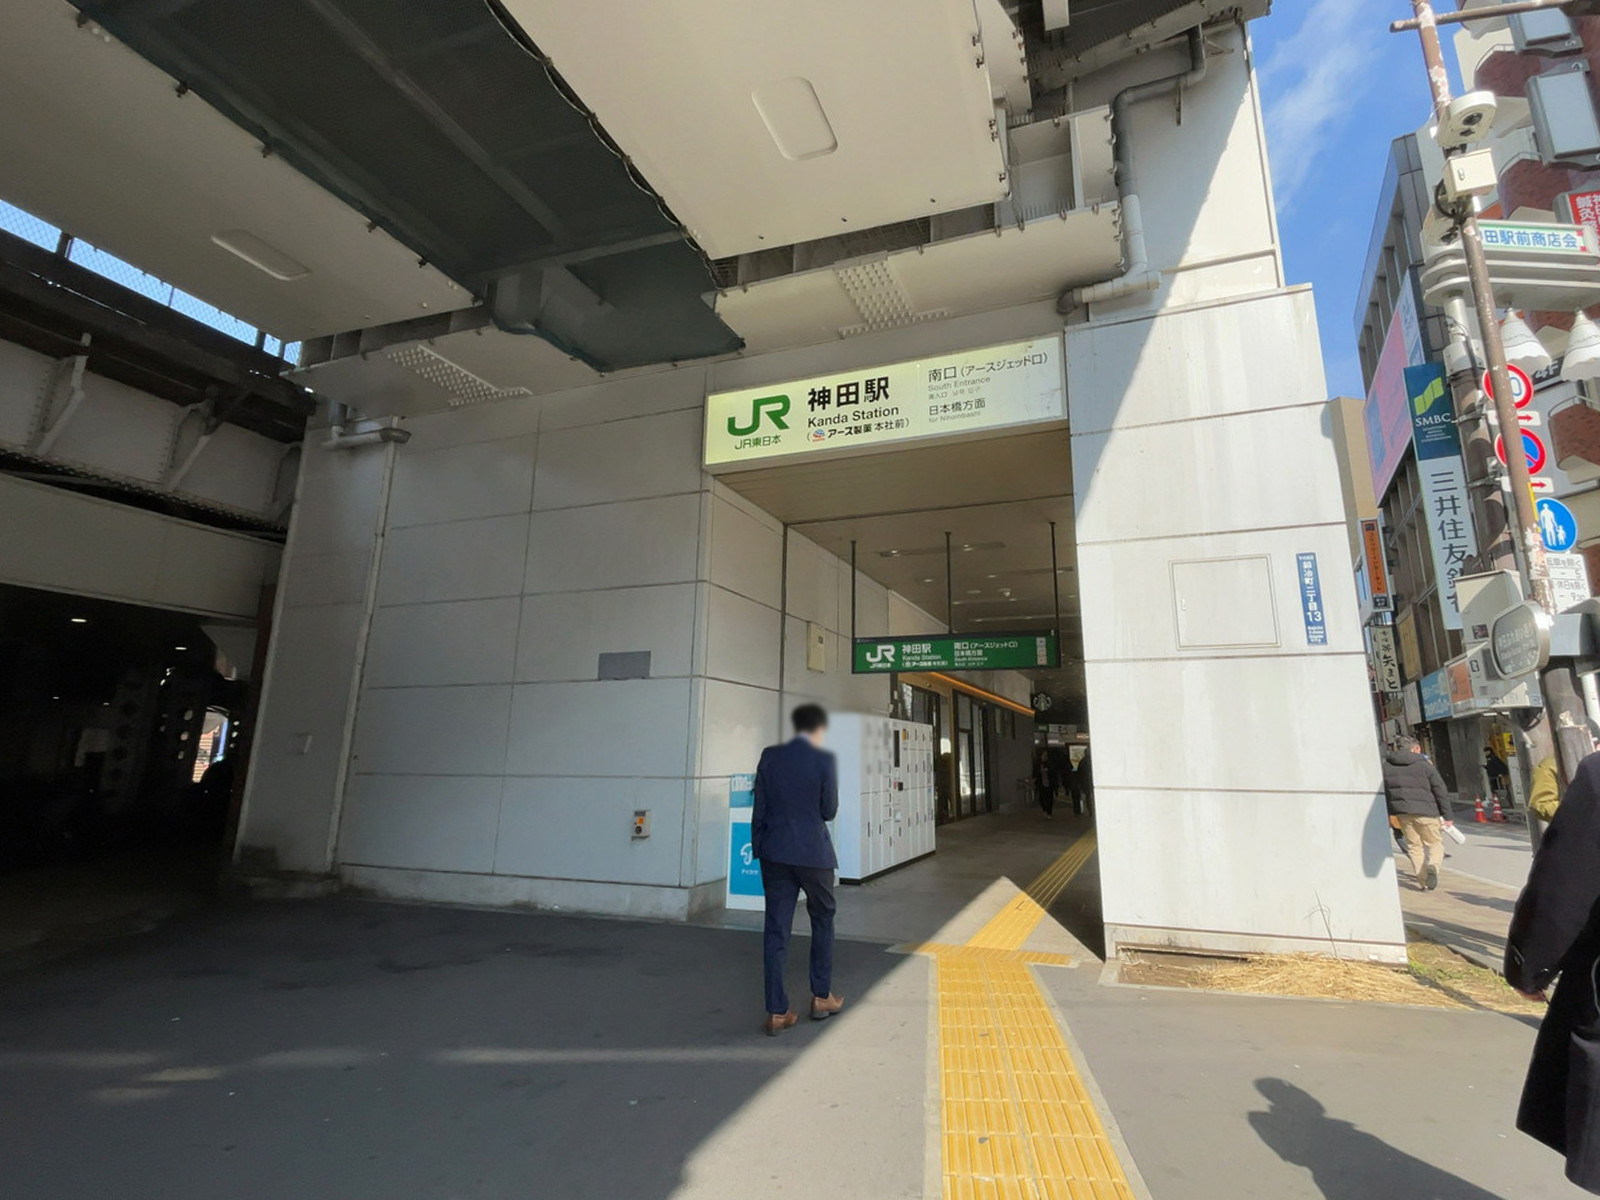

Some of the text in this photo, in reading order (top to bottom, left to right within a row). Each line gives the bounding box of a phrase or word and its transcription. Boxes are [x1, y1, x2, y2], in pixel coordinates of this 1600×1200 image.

[1480, 230, 1577, 248] 田駅前商店会
[928, 380, 952, 393] South
[954, 376, 991, 388] Entrance
[808, 376, 890, 412] 神田駅
[727, 394, 791, 437] JR
[929, 398, 986, 416] 日本橋方面
[808, 406, 900, 428] Kanda Station
[1415, 412, 1451, 427] SMBC
[735, 434, 782, 450] JR東日本
[1307, 611, 1322, 622] 13
[866, 645, 895, 662] JR
[902, 644, 931, 654] 神田駅
